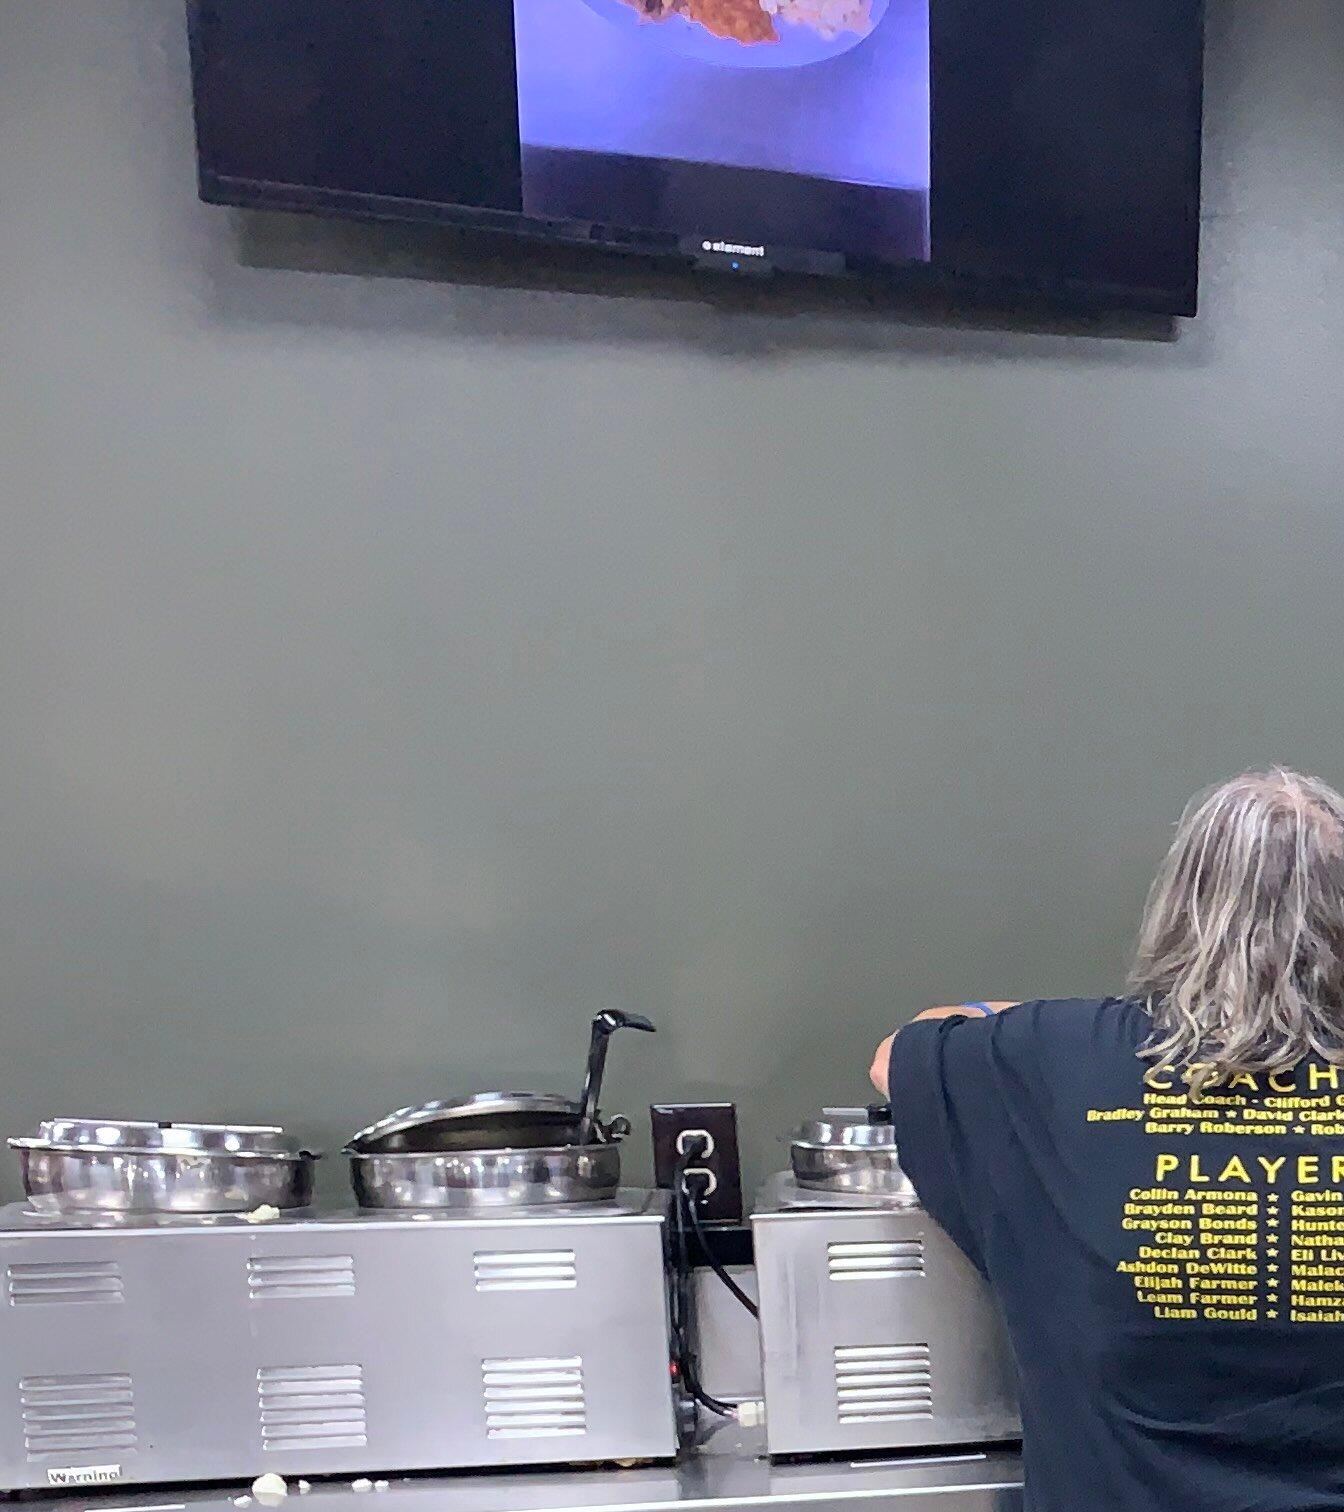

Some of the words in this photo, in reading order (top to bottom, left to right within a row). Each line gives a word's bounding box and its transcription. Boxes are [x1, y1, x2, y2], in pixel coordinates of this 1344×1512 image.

[1143, 1093, 1188, 1106] Head
[1264, 1094, 1331, 1109] Clifford
[1086, 1108, 1145, 1122] Bradley
[1149, 1107, 1220, 1119] Graham
[1242, 1109, 1294, 1121] David
[1144, 1121, 1195, 1135] Barry
[1199, 1122, 1287, 1135] Roberson
[1129, 1188, 1180, 1201] Collin
[1184, 1189, 1258, 1202] Armona
[1290, 1190, 1343, 1203] Gavin
[1124, 1203, 1195, 1216] Brayden
[1201, 1203, 1258, 1216] Beard
[1122, 1218, 1192, 1231] Grayson
[1199, 1217, 1258, 1230] Bonds
[1154, 1232, 1194, 1246] Clay
[1200, 1232, 1258, 1245] Brand
[1138, 1246, 1200, 1259] Declan
[1206, 1247, 1258, 1260] Clark
[1290, 1249, 1314, 1262] Eli
[1116, 1260, 1179, 1274] Ashdon
[1185, 1262, 1258, 1275] DeWitte
[1133, 1275, 1183, 1290] Elijah
[1188, 1276, 1258, 1290] Farmer
[1188, 1292, 1258, 1305] Farmer
[1153, 1306, 1198, 1319] Liam
[1203, 1307, 1258, 1321] Gould
